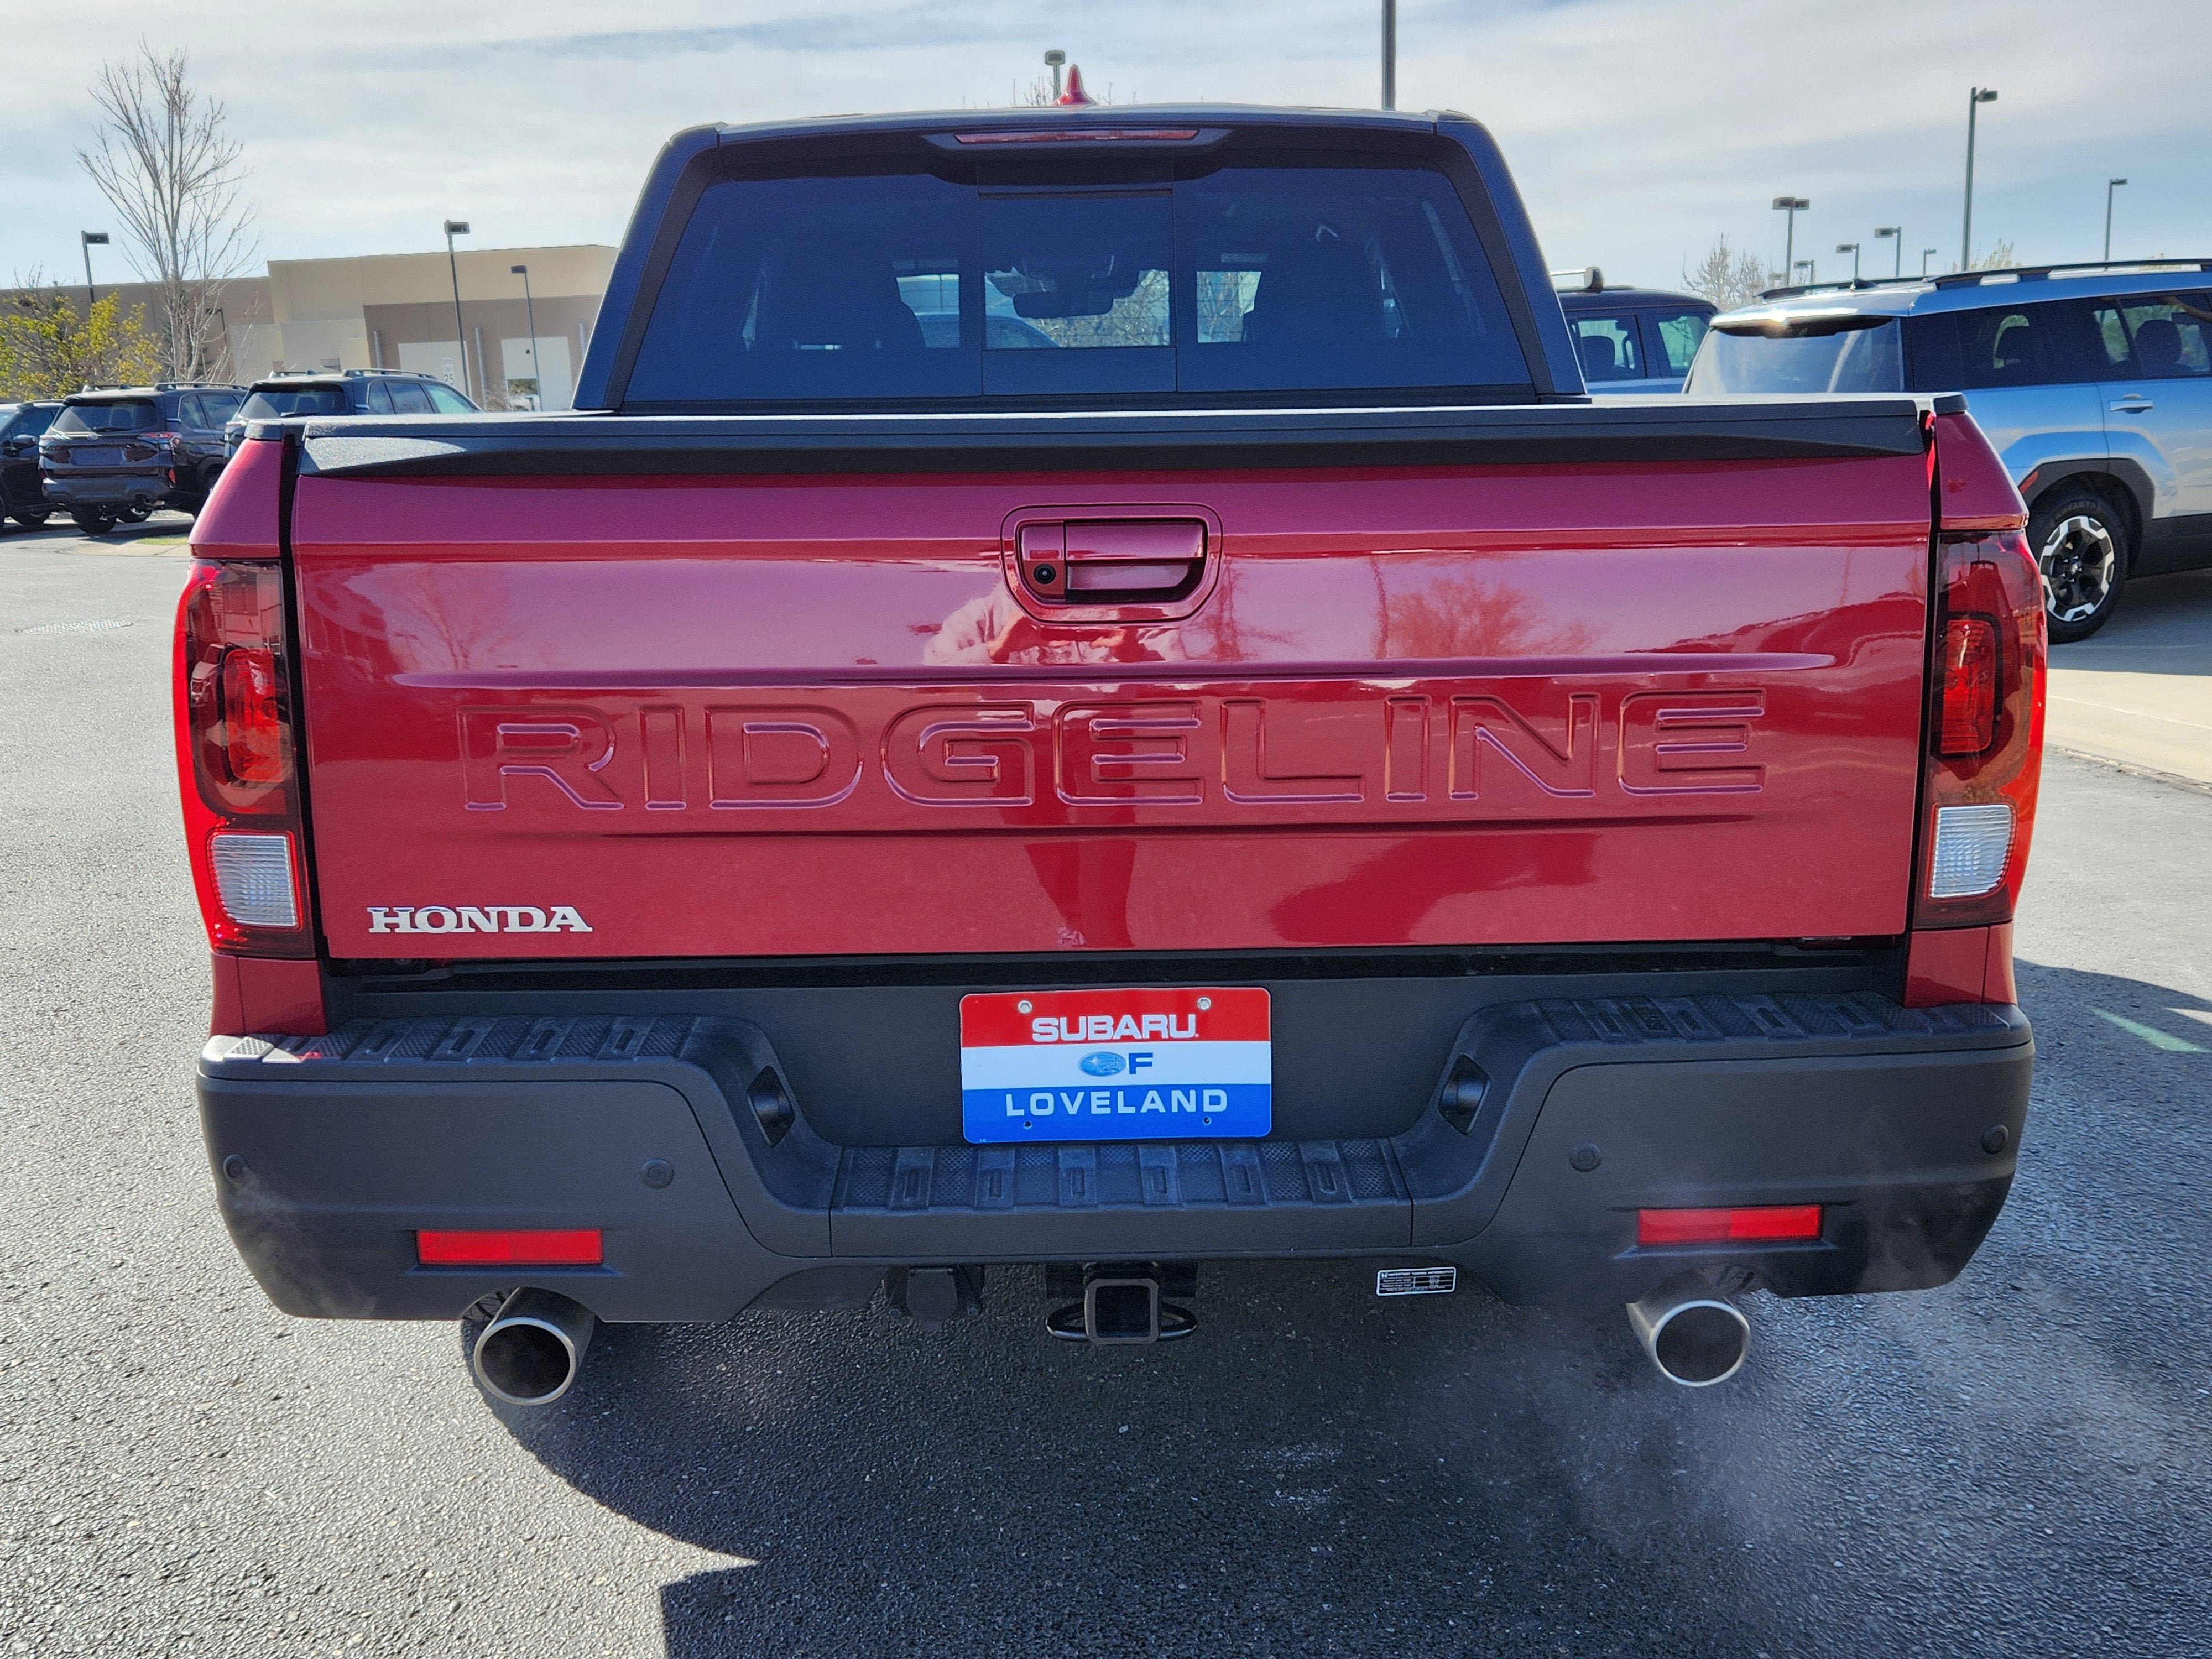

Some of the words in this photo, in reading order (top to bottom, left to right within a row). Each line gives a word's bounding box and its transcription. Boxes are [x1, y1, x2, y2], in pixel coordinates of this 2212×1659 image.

[457, 690, 1766, 811] RIDGELINE
[367, 906, 593, 933] HONDA
[1032, 1014, 1196, 1042] SUBARU
[1006, 1089, 1227, 1117] LOVELAND
